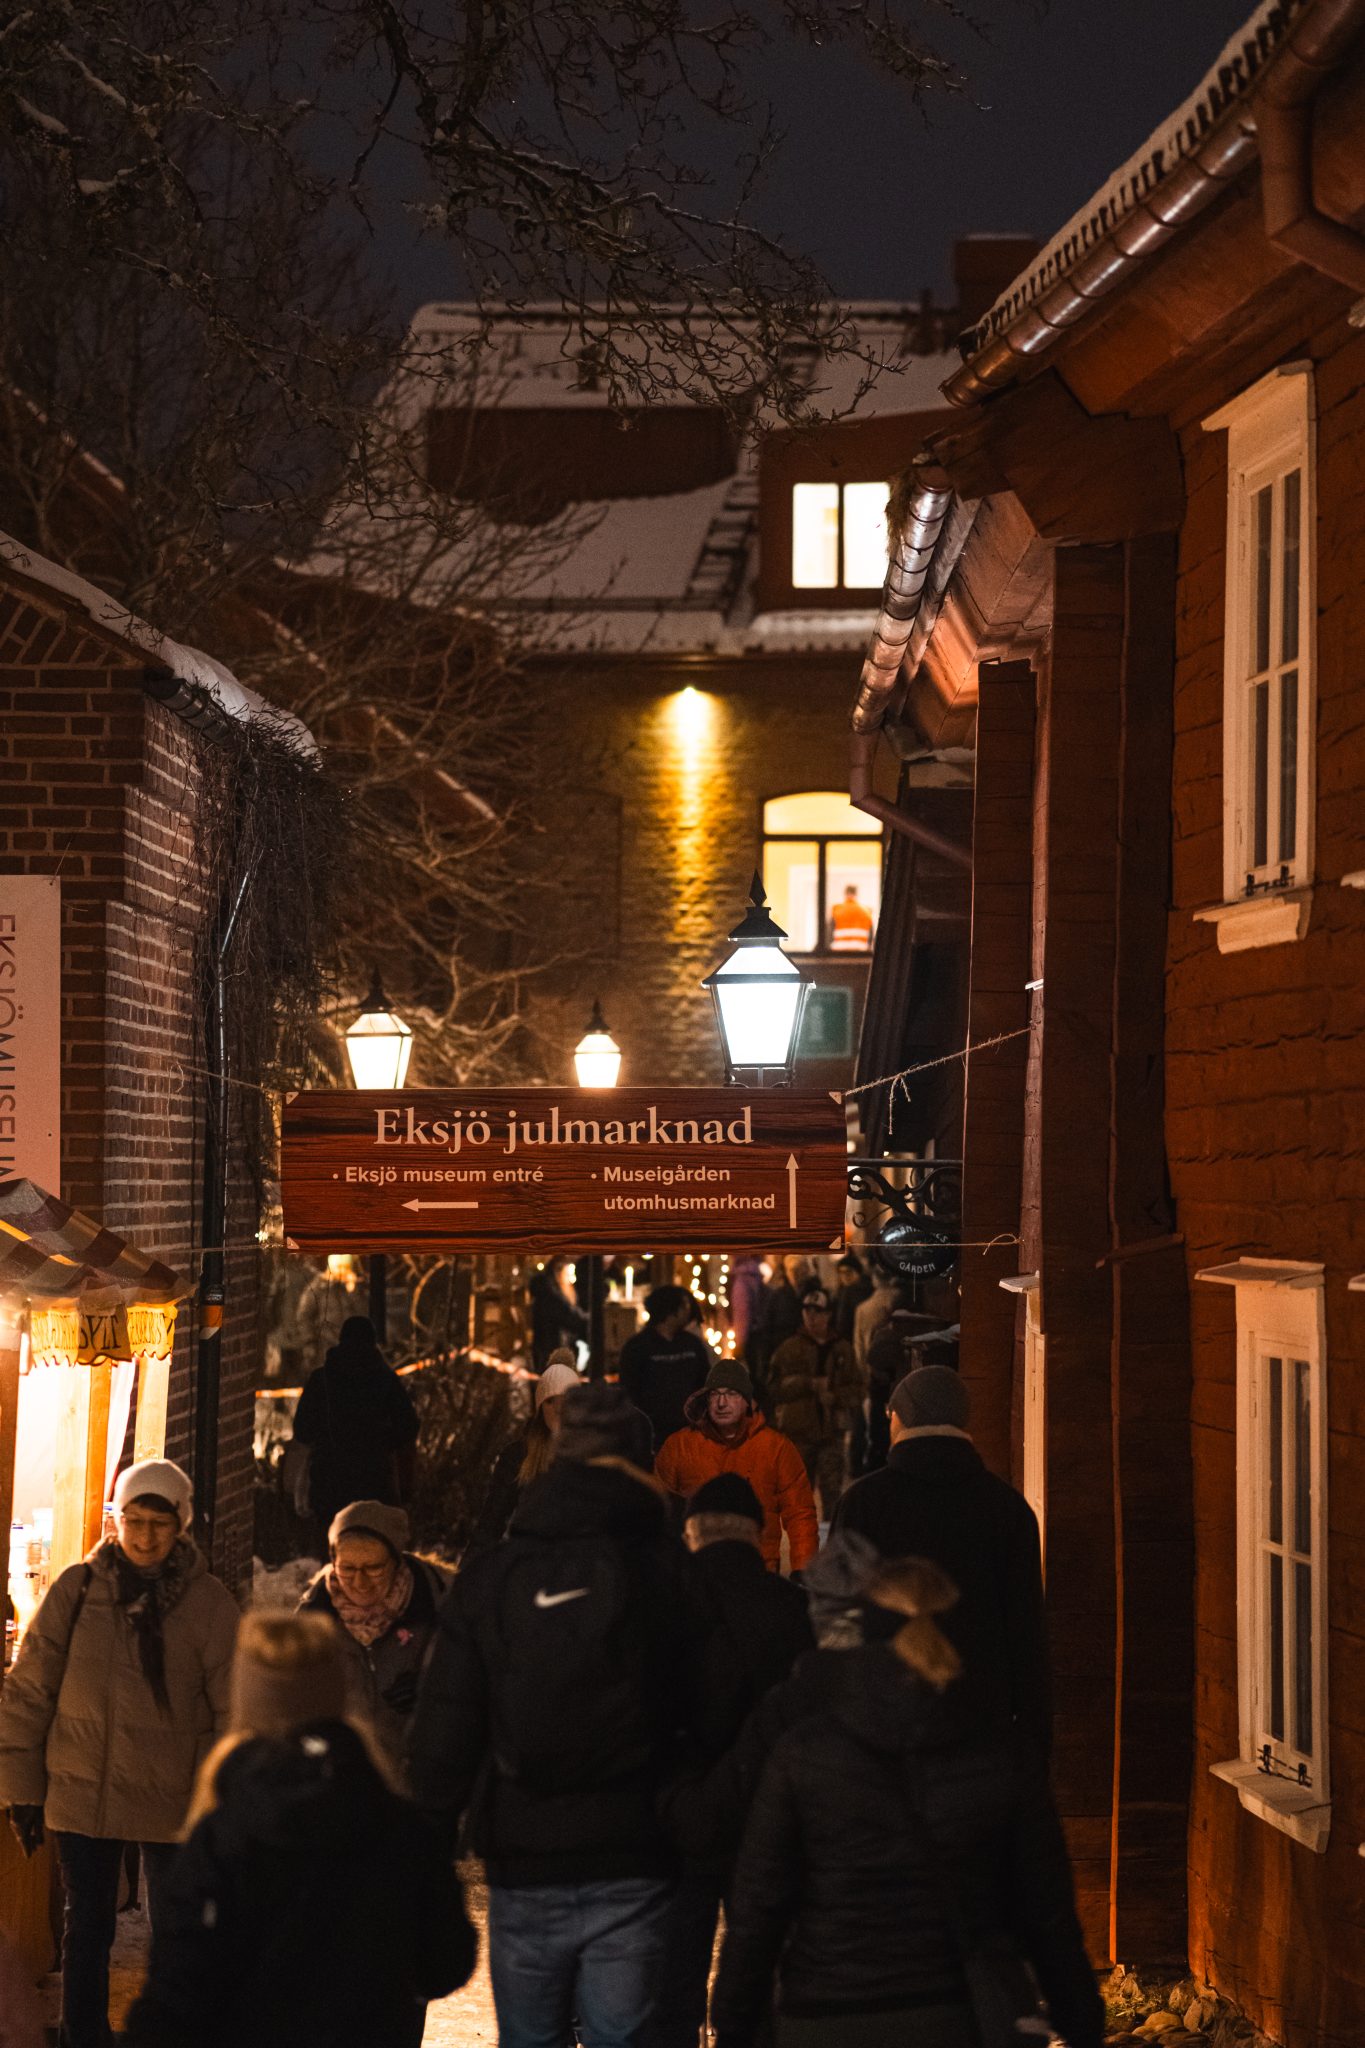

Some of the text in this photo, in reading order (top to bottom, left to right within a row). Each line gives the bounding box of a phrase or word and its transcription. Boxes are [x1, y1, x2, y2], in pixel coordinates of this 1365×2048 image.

[373, 1105, 755, 1155] Eksjö julmarknad
[345, 1165, 544, 1187] Eksjö museum entré
[603, 1165, 731, 1186] Museigården
[604, 1193, 775, 1210] utomhusmarknad
